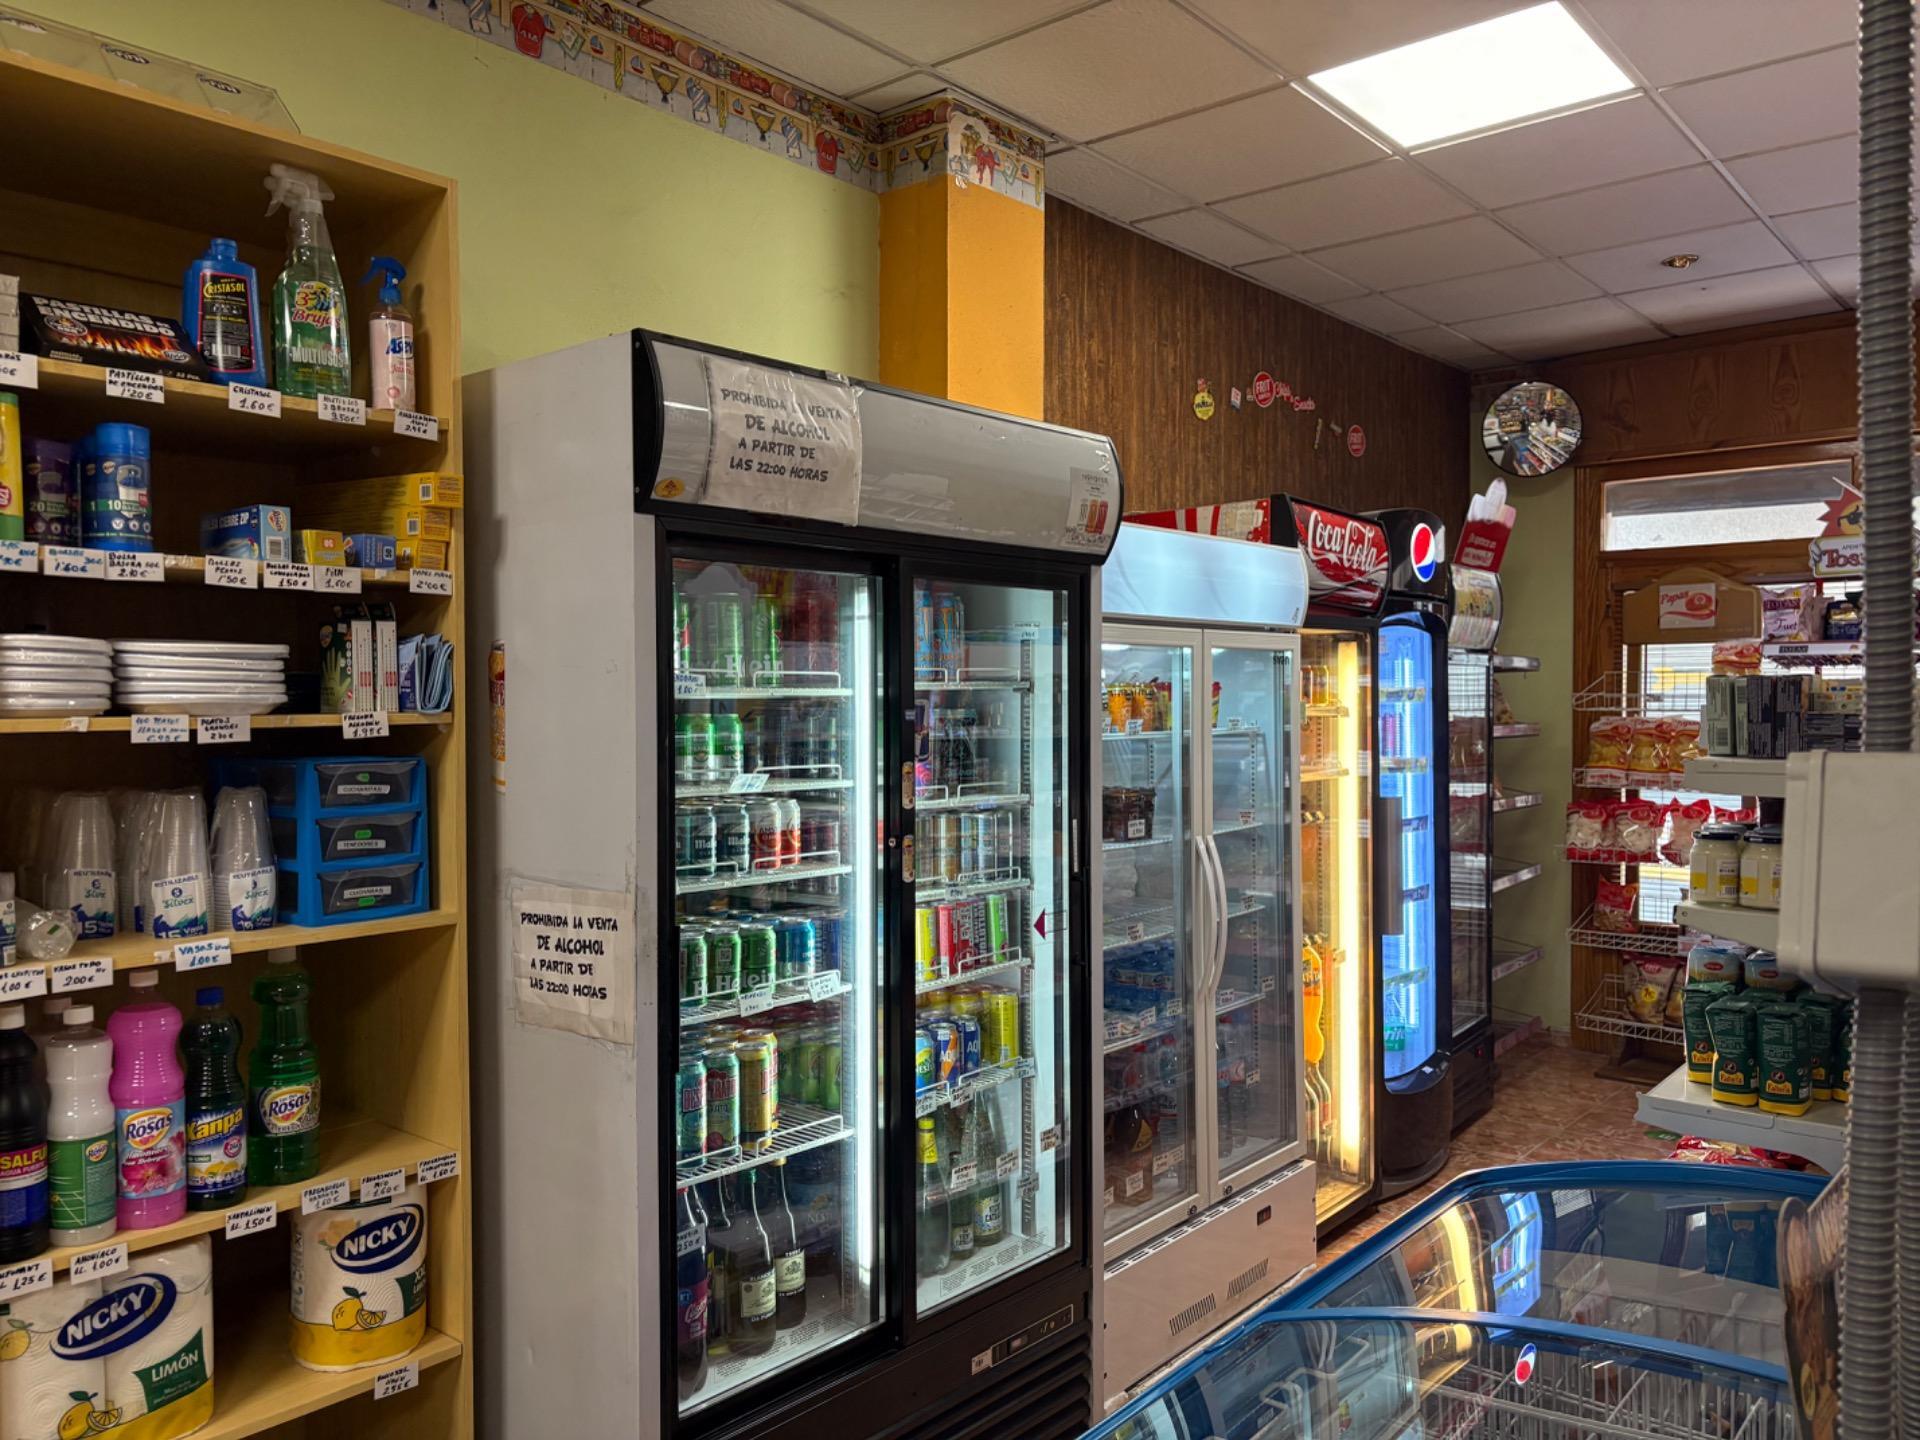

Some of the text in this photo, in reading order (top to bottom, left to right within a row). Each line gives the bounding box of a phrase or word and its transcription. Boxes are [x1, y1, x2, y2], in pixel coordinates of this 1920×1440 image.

[203, 281, 246, 298] CRISTASOL
[296, 291, 309, 306] 3
[32, 296, 154, 325] PASTILLAS
[38, 306, 175, 337] ENCENDIDO
[292, 307, 341, 329] Brujas
[292, 347, 346, 368] MULTIUSOS
[720, 388, 787, 411] PROHIBIDA
[808, 405, 843, 420] VENTA
[745, 413, 766, 432] DE
[738, 437, 816, 459] A PARTIR DE
[729, 456, 829, 482] LAS 22:00 HORAS
[108, 499, 122, 512] 10
[1307, 510, 1378, 574] Coca-Cola
[1660, 591, 1690, 605] Papas
[521, 912, 618, 931] PROHIBIDA LA VENTA
[537, 935, 604, 955] DE ALCOHOL
[530, 958, 594, 976] A PARTIR DE
[529, 977, 607, 1000] LAS 22:00 HORAS
[269, 1090, 311, 1117] Rosas
[126, 1112, 173, 1141] Rosas
[0, 1149, 48, 1169] SALFU
[343, 1214, 411, 1258] NICKY
[66, 1285, 147, 1347] NICKY
[150, 1349, 199, 1382] LIMÓN
